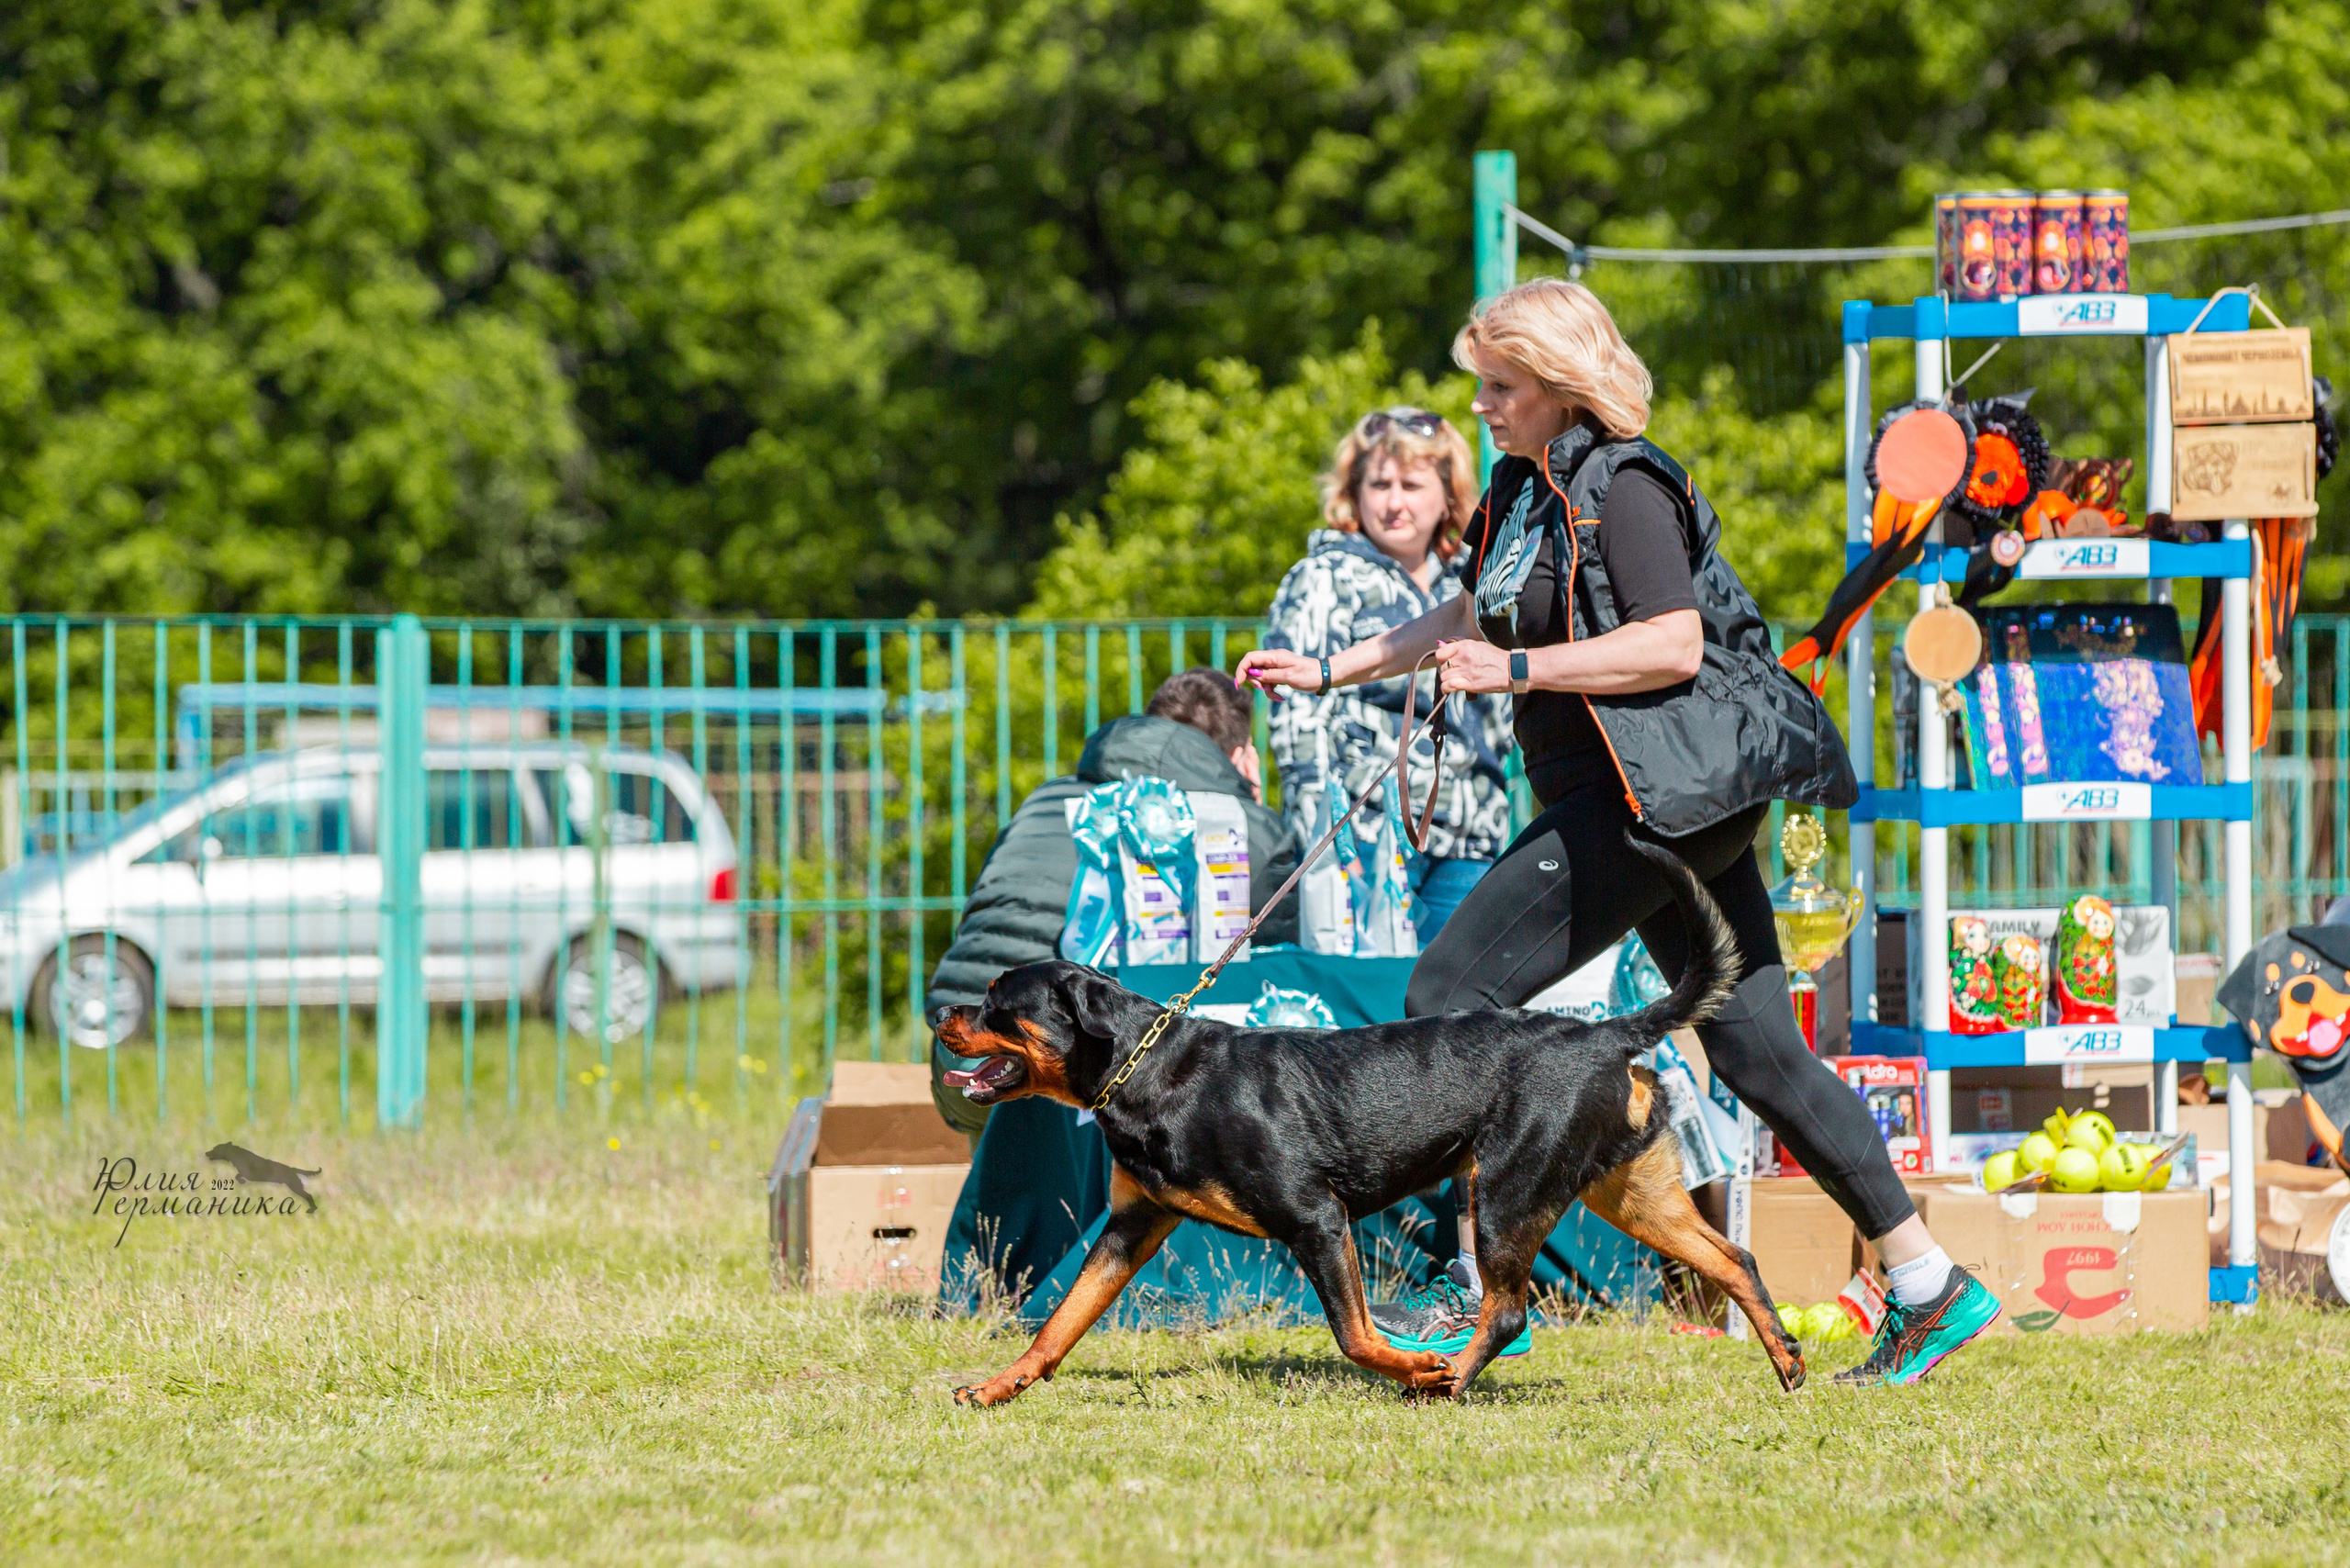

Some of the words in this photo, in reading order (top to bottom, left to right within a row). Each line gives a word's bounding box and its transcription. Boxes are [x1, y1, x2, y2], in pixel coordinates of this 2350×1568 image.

[1989, 919, 2042, 934] AMILY
[2124, 999, 2145, 1017] 24
[2065, 1250, 2101, 1267] 1997
